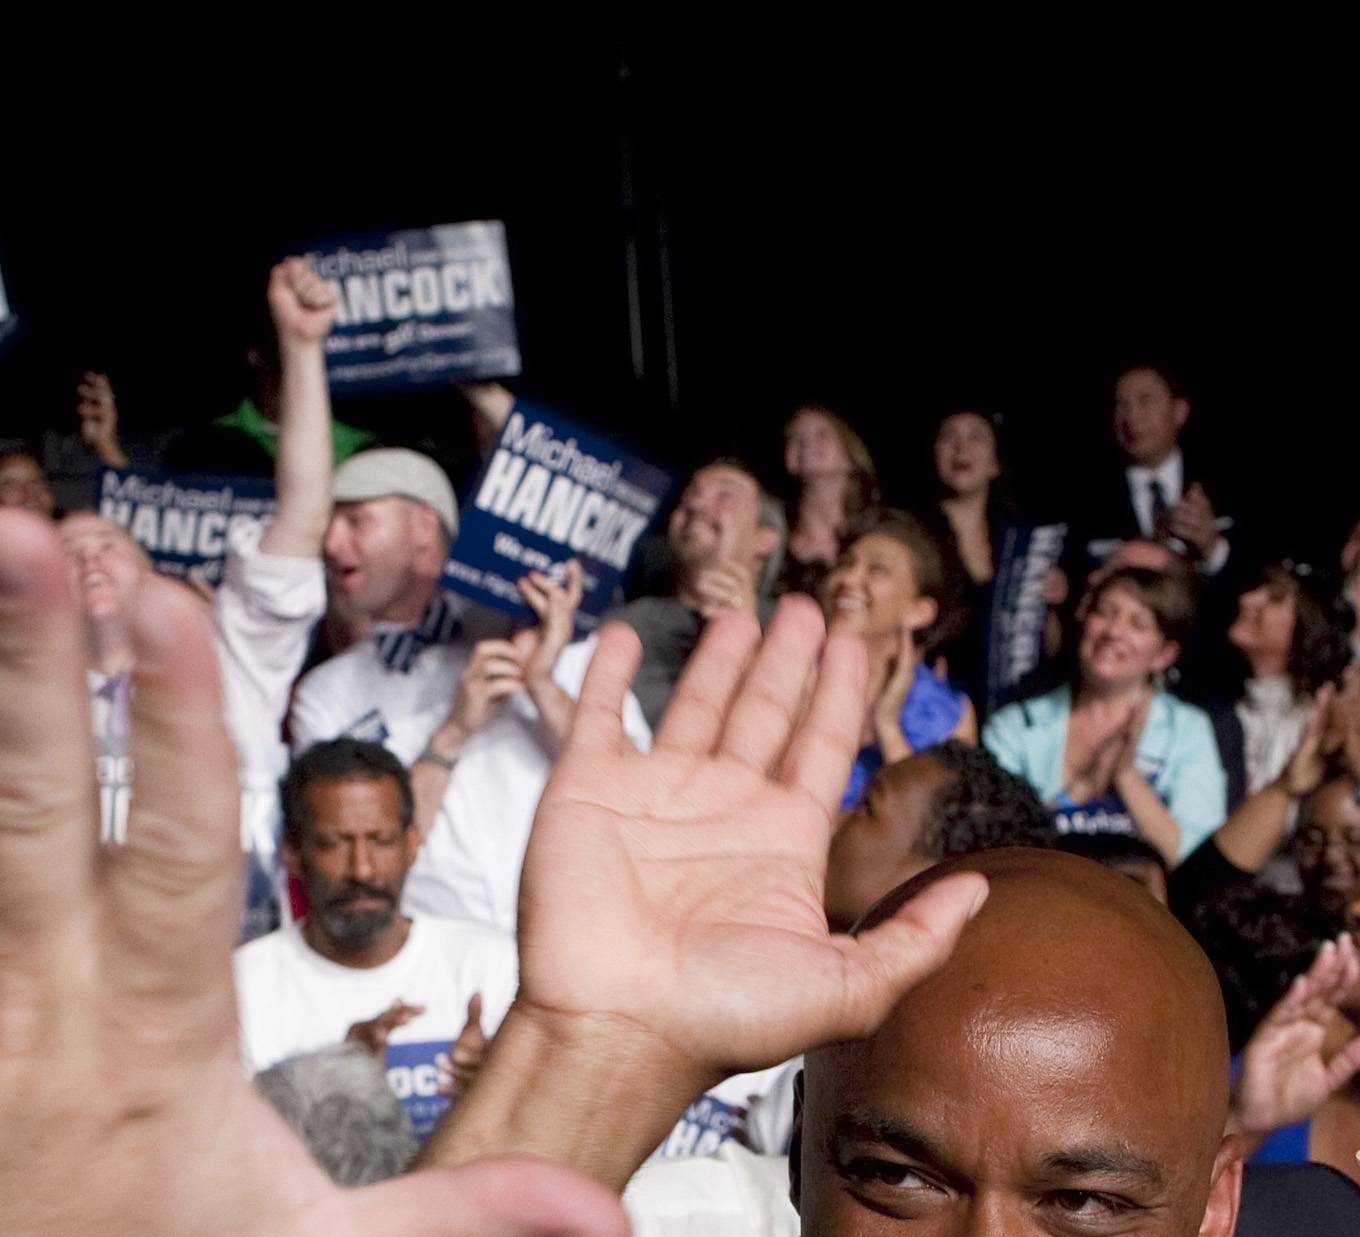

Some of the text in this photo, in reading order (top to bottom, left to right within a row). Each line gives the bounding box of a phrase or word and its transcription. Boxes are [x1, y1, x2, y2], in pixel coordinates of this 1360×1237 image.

[326, 254, 508, 328] ANCOCK
[499, 411, 624, 486] Michael
[101, 469, 233, 512] Michael
